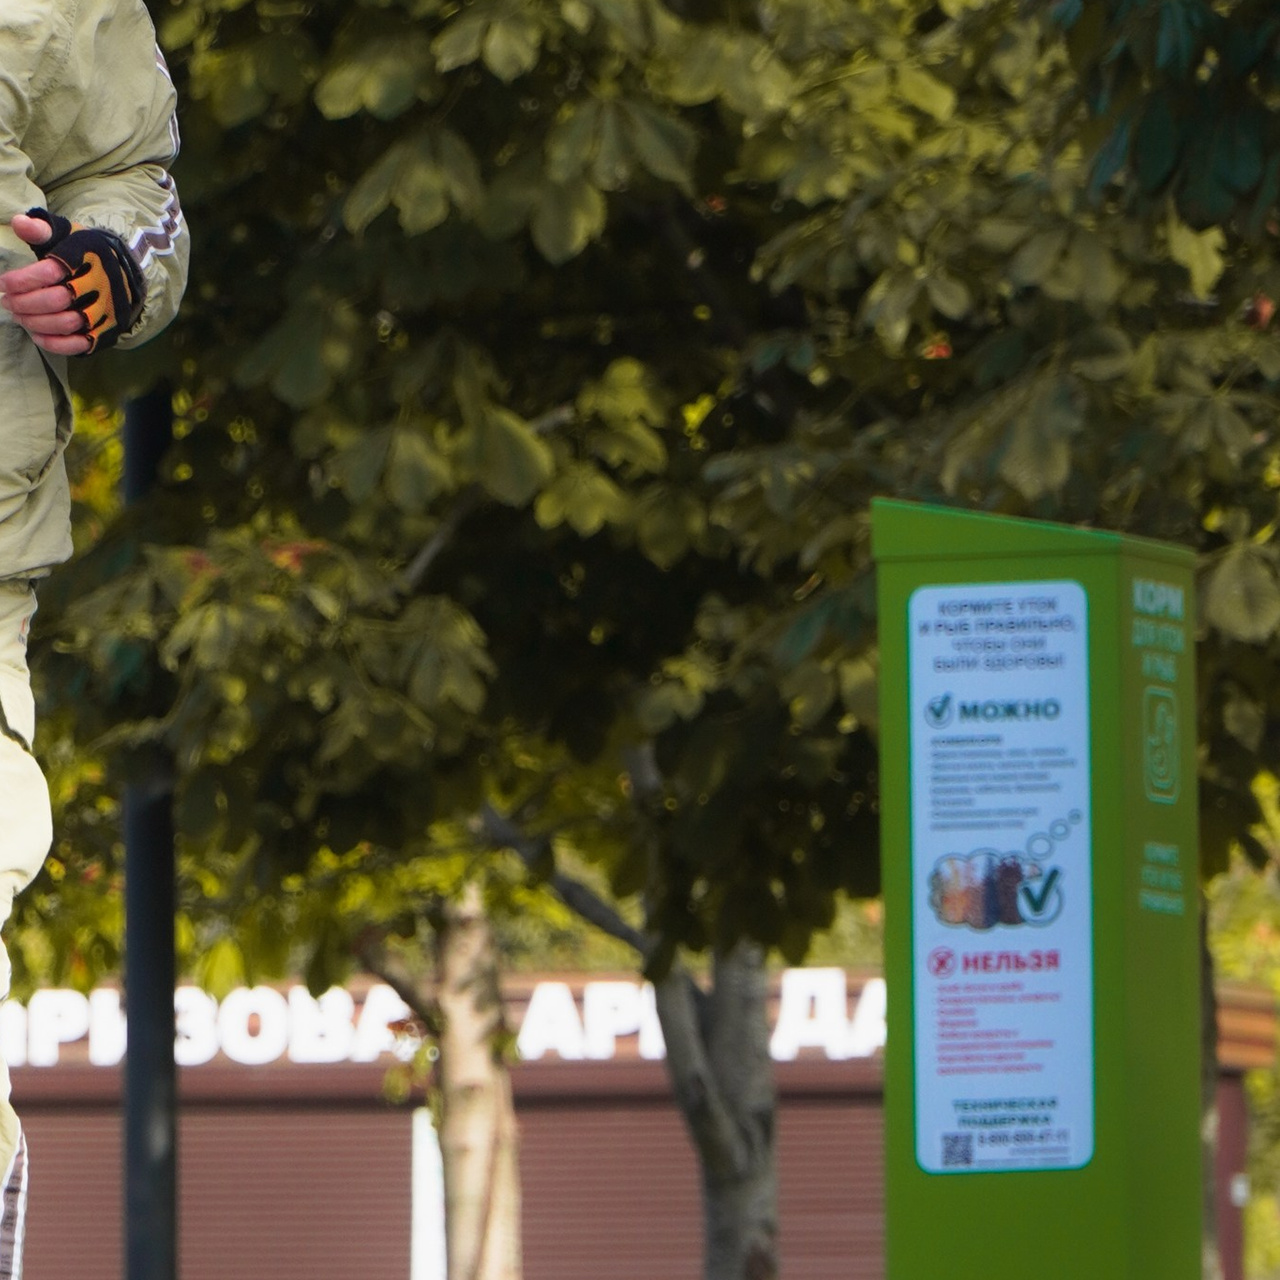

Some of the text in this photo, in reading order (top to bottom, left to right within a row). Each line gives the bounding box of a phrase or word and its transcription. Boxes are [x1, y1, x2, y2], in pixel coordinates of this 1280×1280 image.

[938, 598, 1014, 616] КОРМИТЕ
[952, 635, 1047, 653] ЧТОБЫ ОНИ
[933, 655, 979, 673] БЫЛИ
[958, 698, 1062, 723] МОЖНО
[962, 948, 1061, 974] НЕЛЬЗЯ
